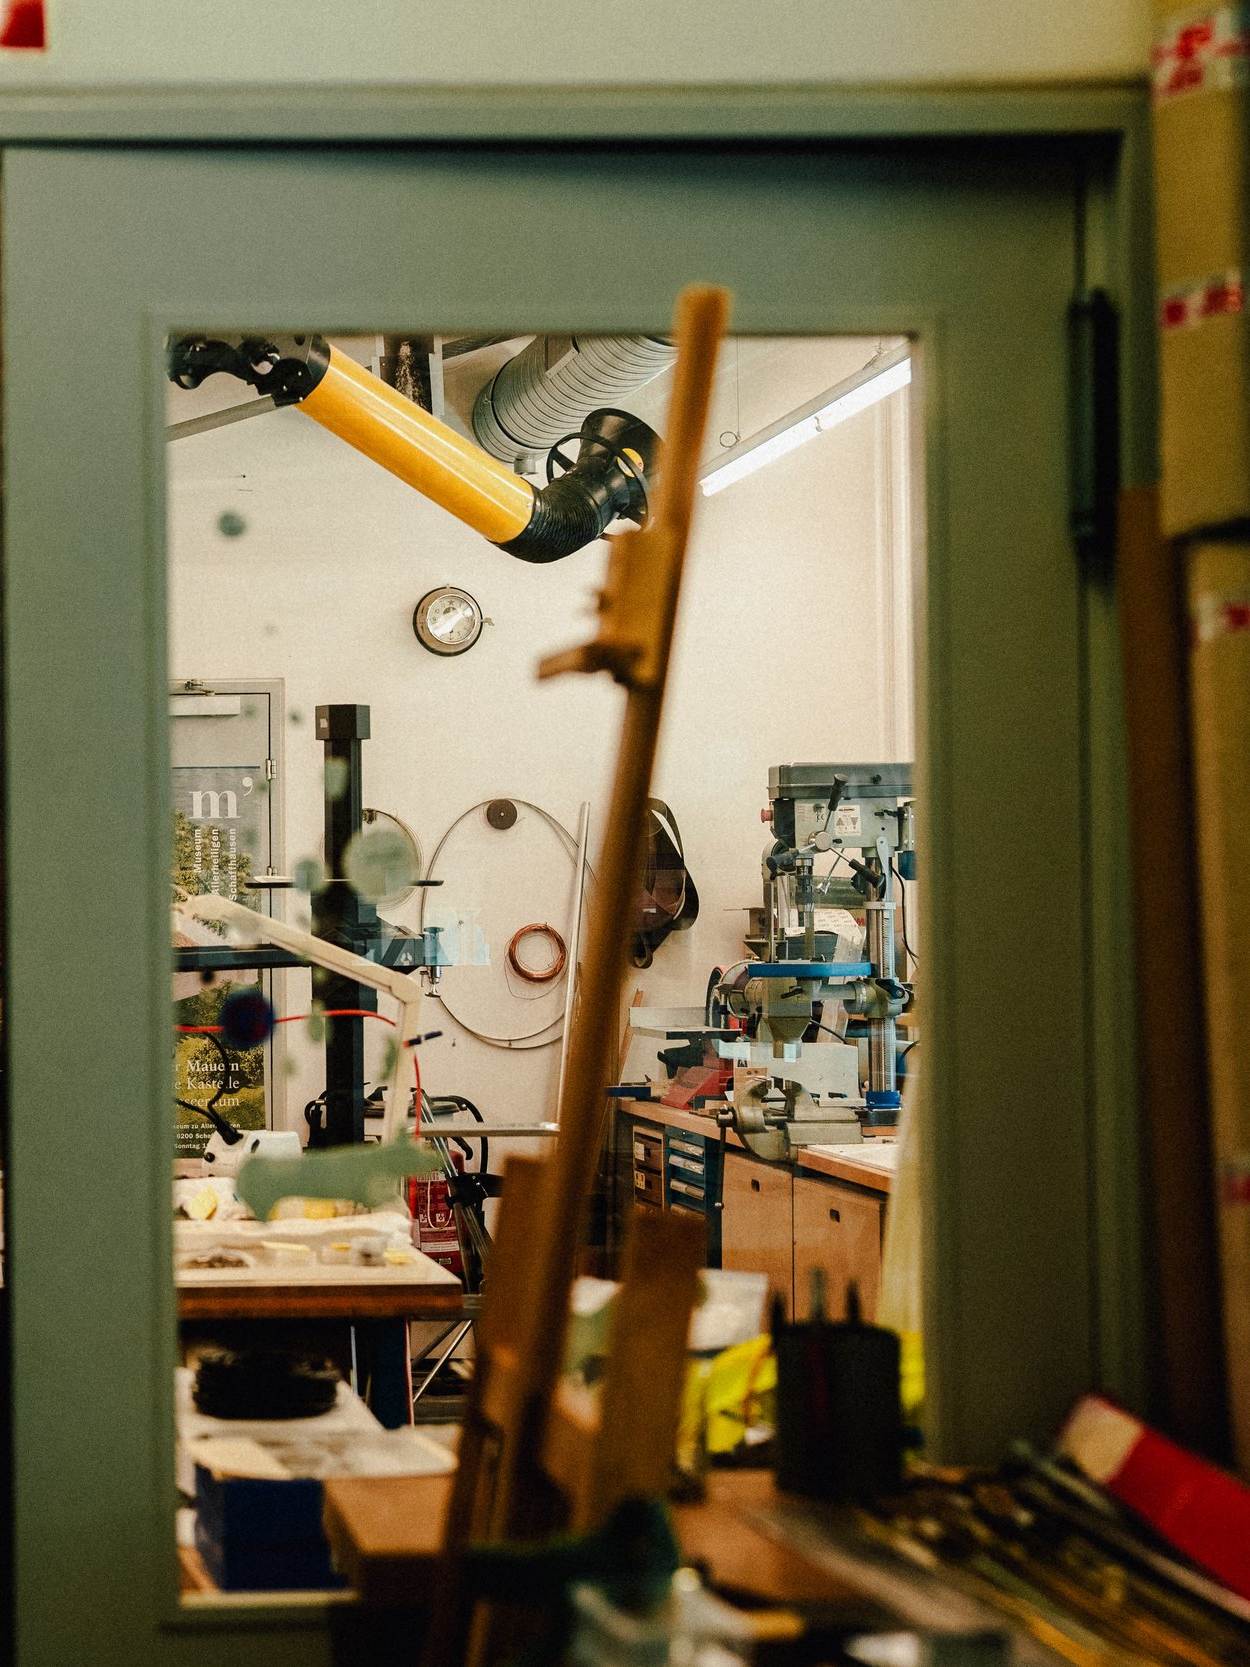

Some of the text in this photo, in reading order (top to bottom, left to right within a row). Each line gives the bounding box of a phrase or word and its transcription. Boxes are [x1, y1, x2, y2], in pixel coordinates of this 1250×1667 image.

[193, 829, 202, 873] Museum
[211, 828, 221, 895] Allerheiligen
[228, 828, 237, 901] Schaffhausen
[186, 1059, 240, 1072] Mauen
[186, 1076, 240, 1090] Kastele
